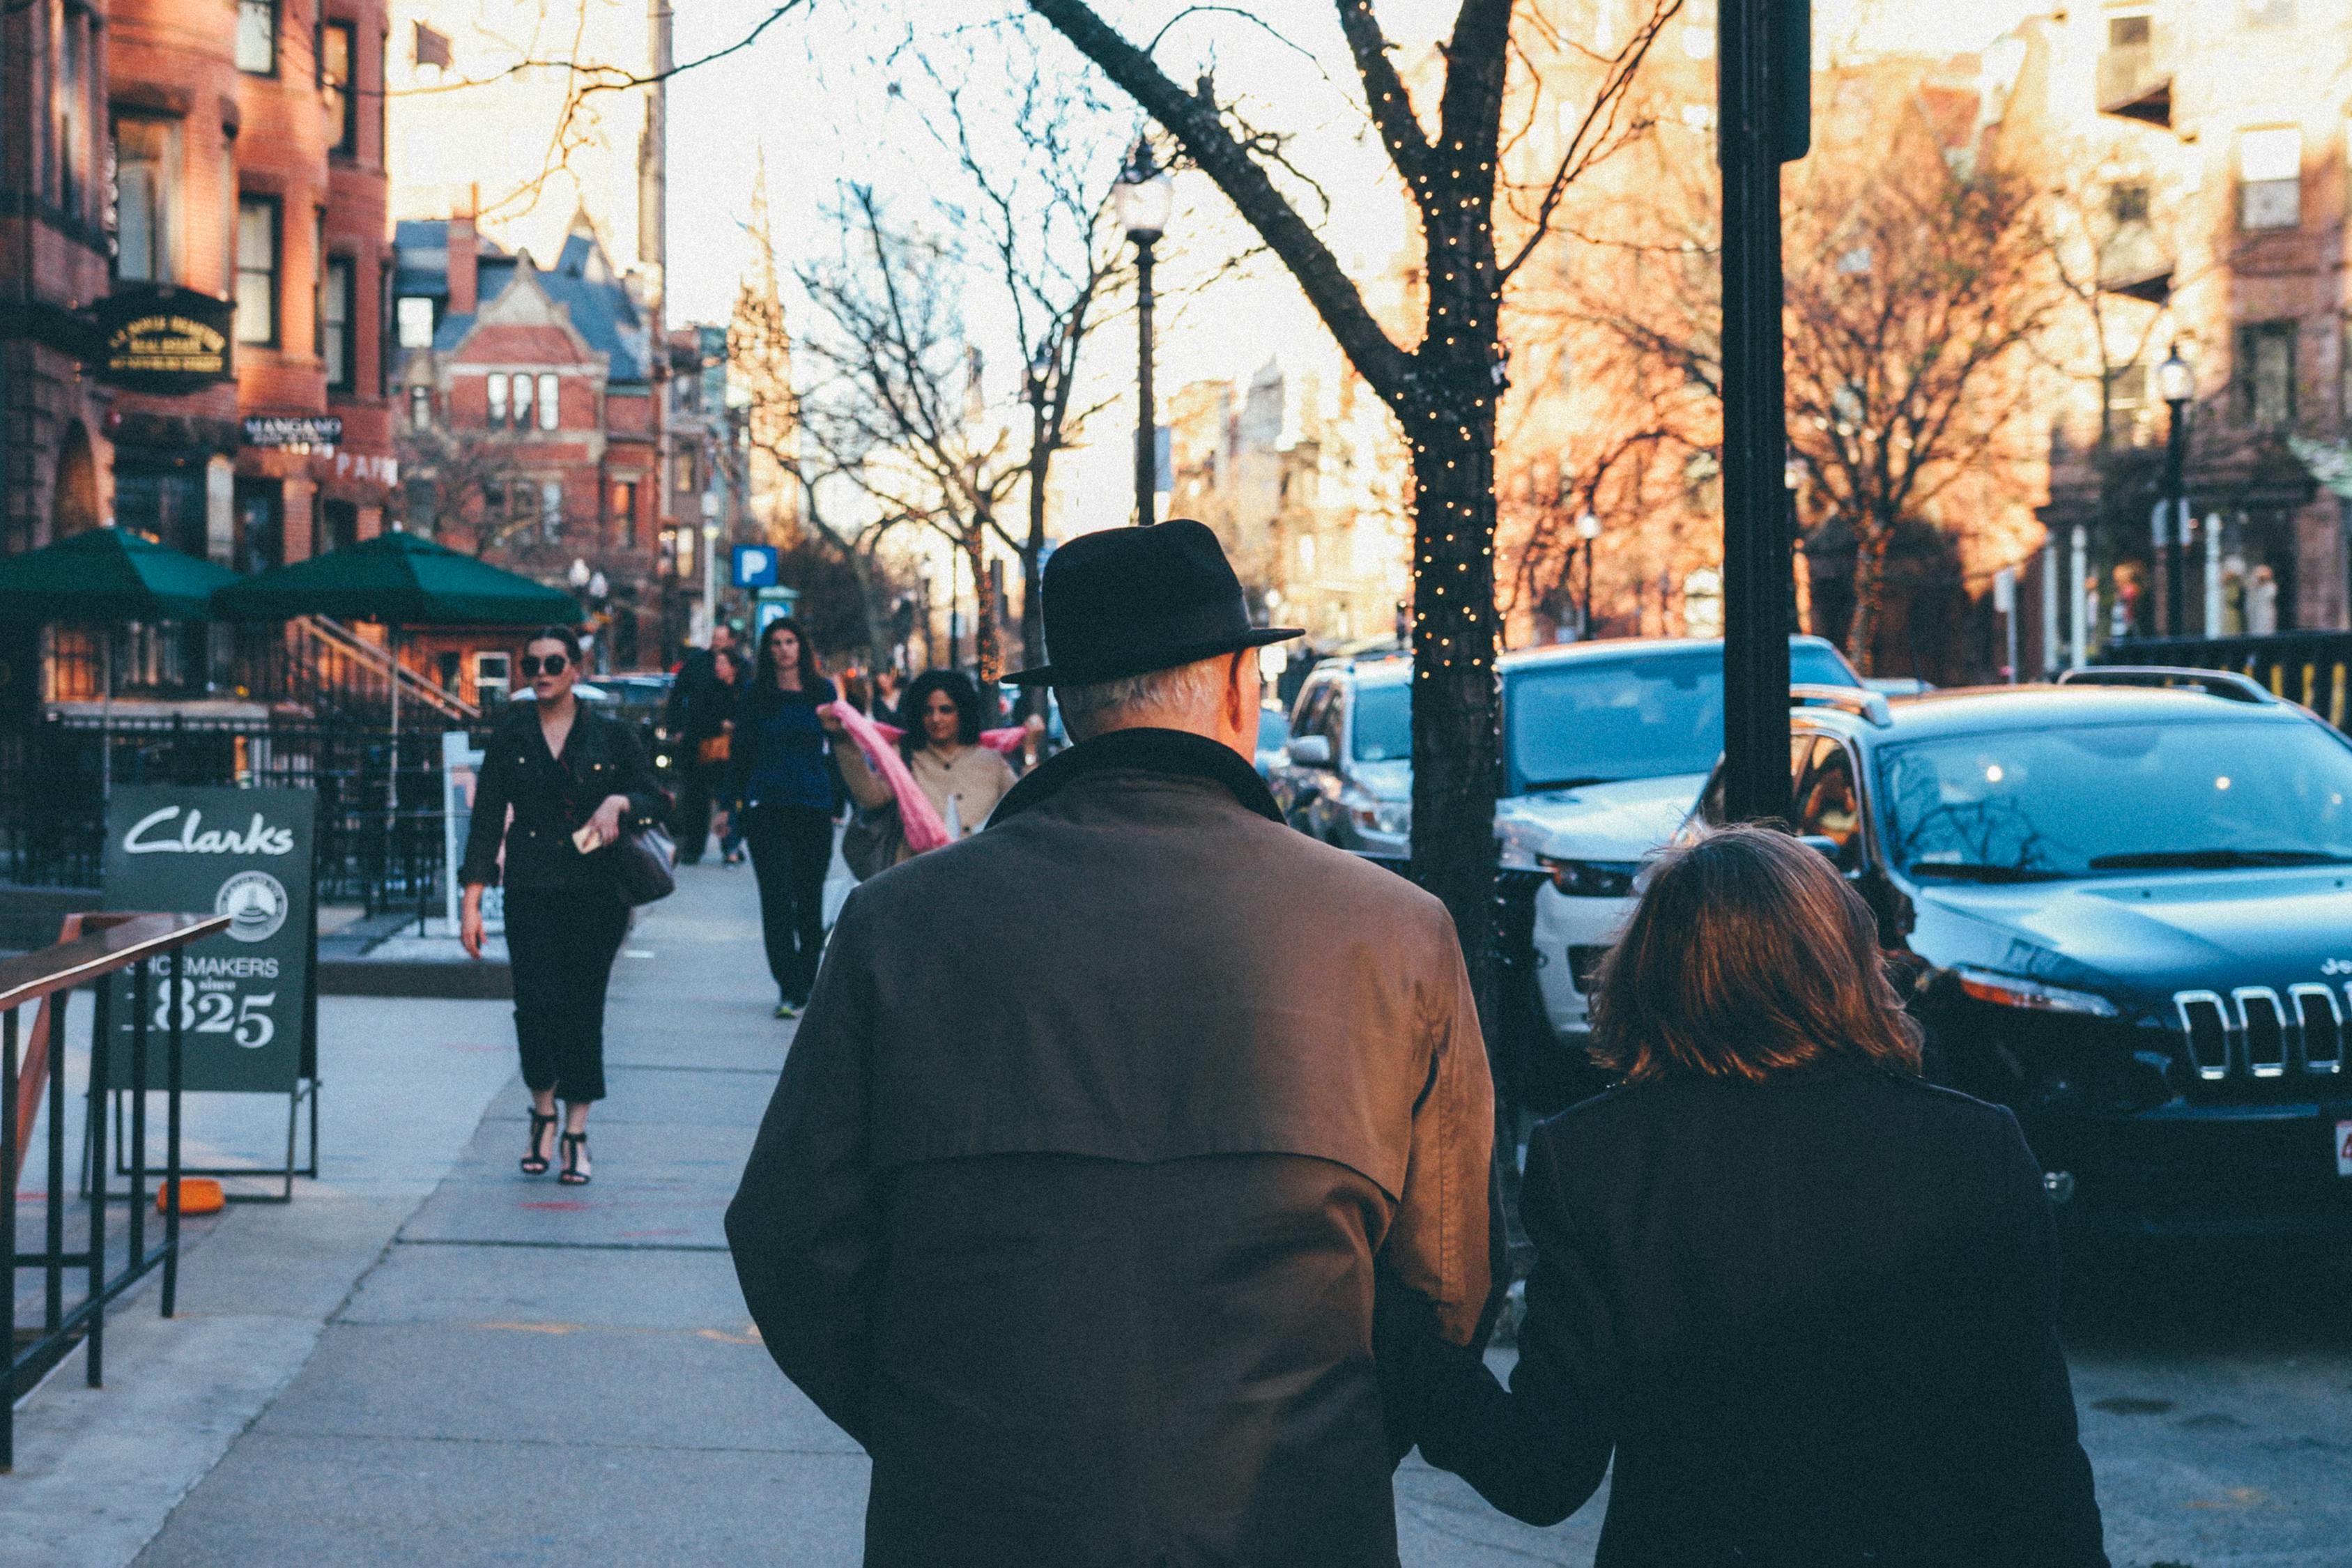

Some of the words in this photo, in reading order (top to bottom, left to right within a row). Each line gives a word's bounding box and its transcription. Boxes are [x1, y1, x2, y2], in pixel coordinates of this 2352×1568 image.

[741, 549, 767, 583] P
[123, 805, 294, 856] Clarks
[121, 978, 277, 1049] 825
